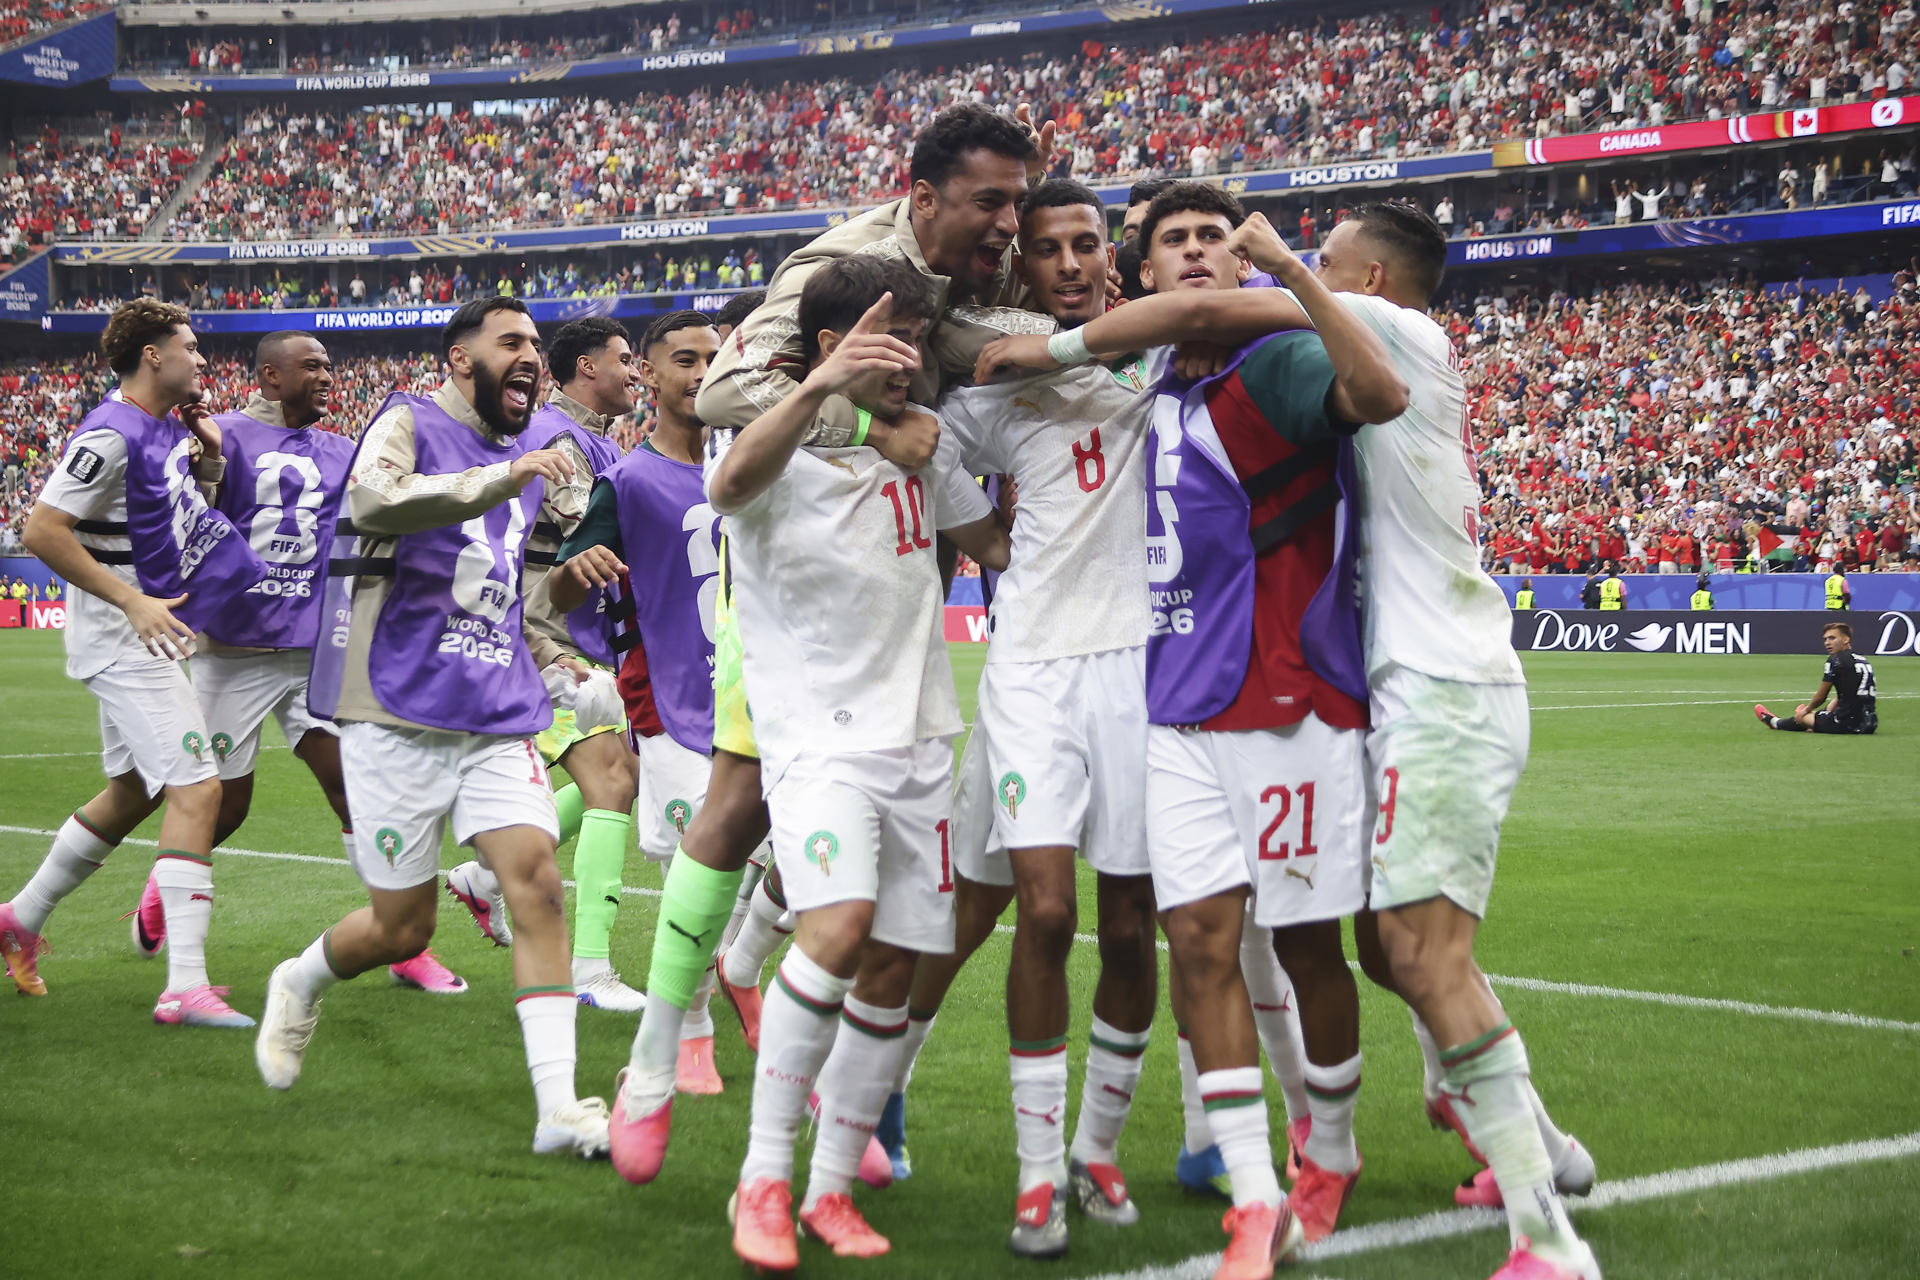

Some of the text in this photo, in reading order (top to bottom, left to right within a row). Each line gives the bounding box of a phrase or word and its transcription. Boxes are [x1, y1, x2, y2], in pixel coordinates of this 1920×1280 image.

[642, 50, 726, 71] HOUSTON
[296, 73, 430, 90] FIFA WORLD CUP 2026
[1599, 131, 1661, 152] CANADA
[1289, 163, 1398, 186] HOUSTON
[621, 221, 708, 240] HOUSTON
[229, 242, 370, 258] FIFA WORLD CUP 2026
[1465, 237, 1552, 260] HOUSTON
[315, 308, 459, 328] FIFA WORLD CUP 202
[1072, 426, 1106, 493] 8
[880, 475, 931, 557] 10
[270, 540, 301, 553] FIFA
[1146, 546, 1166, 565] FIFA
[292, 570, 315, 579] CUP
[489, 629, 512, 646] CUP
[1531, 610, 1750, 654] Dove MEN
[438, 632, 514, 668] 2026
[1258, 780, 1318, 860] 21
